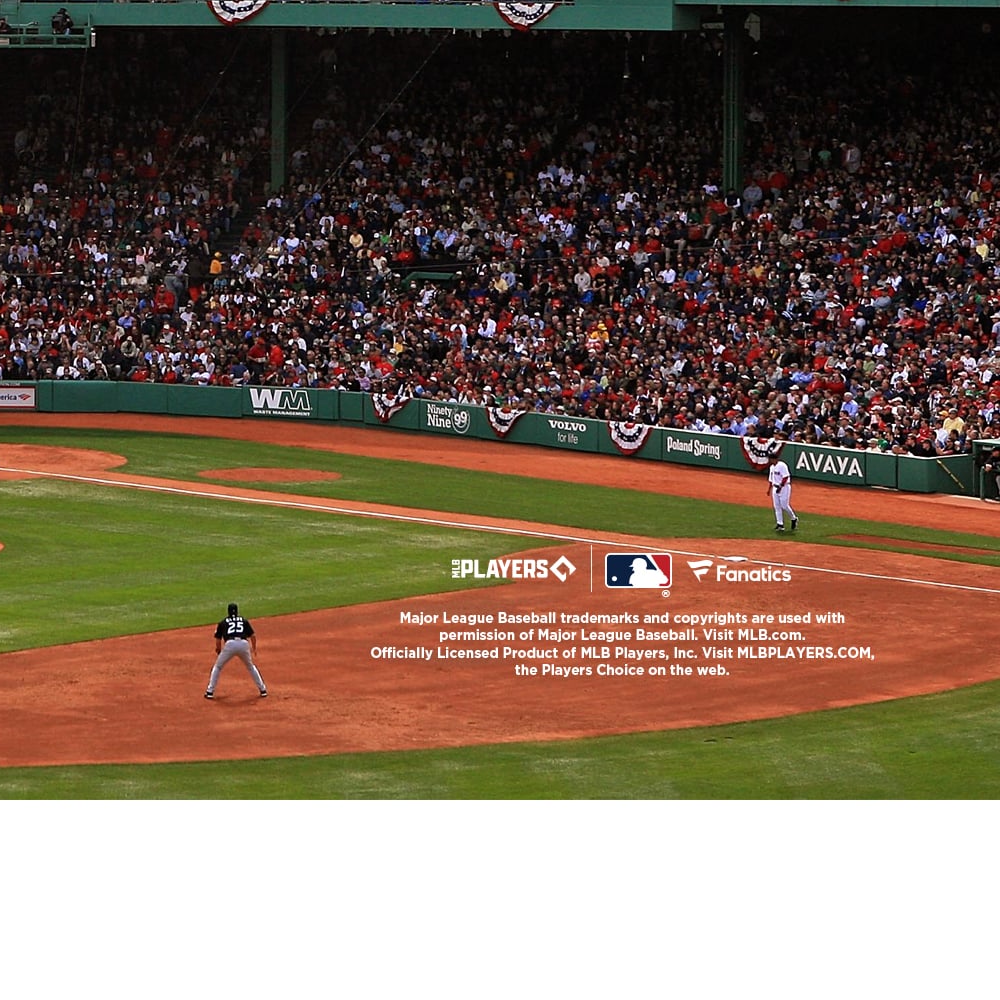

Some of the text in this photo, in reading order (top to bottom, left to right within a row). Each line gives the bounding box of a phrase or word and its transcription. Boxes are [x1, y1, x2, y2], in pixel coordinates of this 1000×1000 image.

[250, 388, 310, 410] WM
[427, 403, 452, 418] Ninety
[427, 413, 451, 428] Nine
[454, 410, 467, 427] 99
[548, 419, 587, 432] VOLVO
[557, 432, 579, 444] for life
[667, 436, 721, 459] Poland Spring
[796, 451, 863, 478] AVAYA
[227, 622, 244, 634] 25
